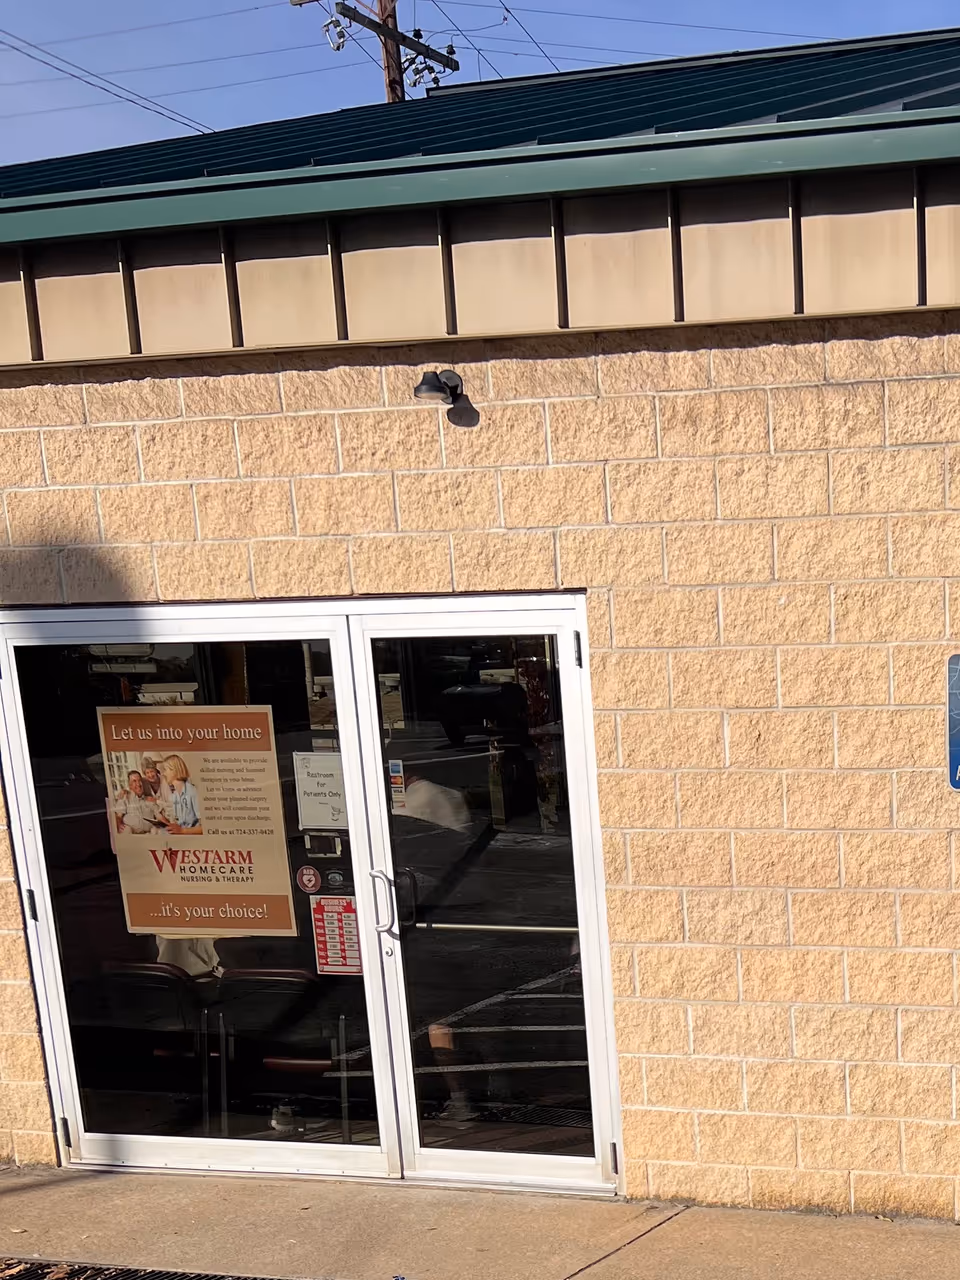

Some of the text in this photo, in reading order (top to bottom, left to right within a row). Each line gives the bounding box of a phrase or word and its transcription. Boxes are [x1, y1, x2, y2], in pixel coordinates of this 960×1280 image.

[111, 724, 262, 744] Let us into your home
[303, 790, 342, 799] Patients Only
[149, 848, 254, 873] WESTARM
[179, 865, 254, 875] HOMECARE
[184, 905, 215, 921] your
[219, 903, 268, 918] choice!
